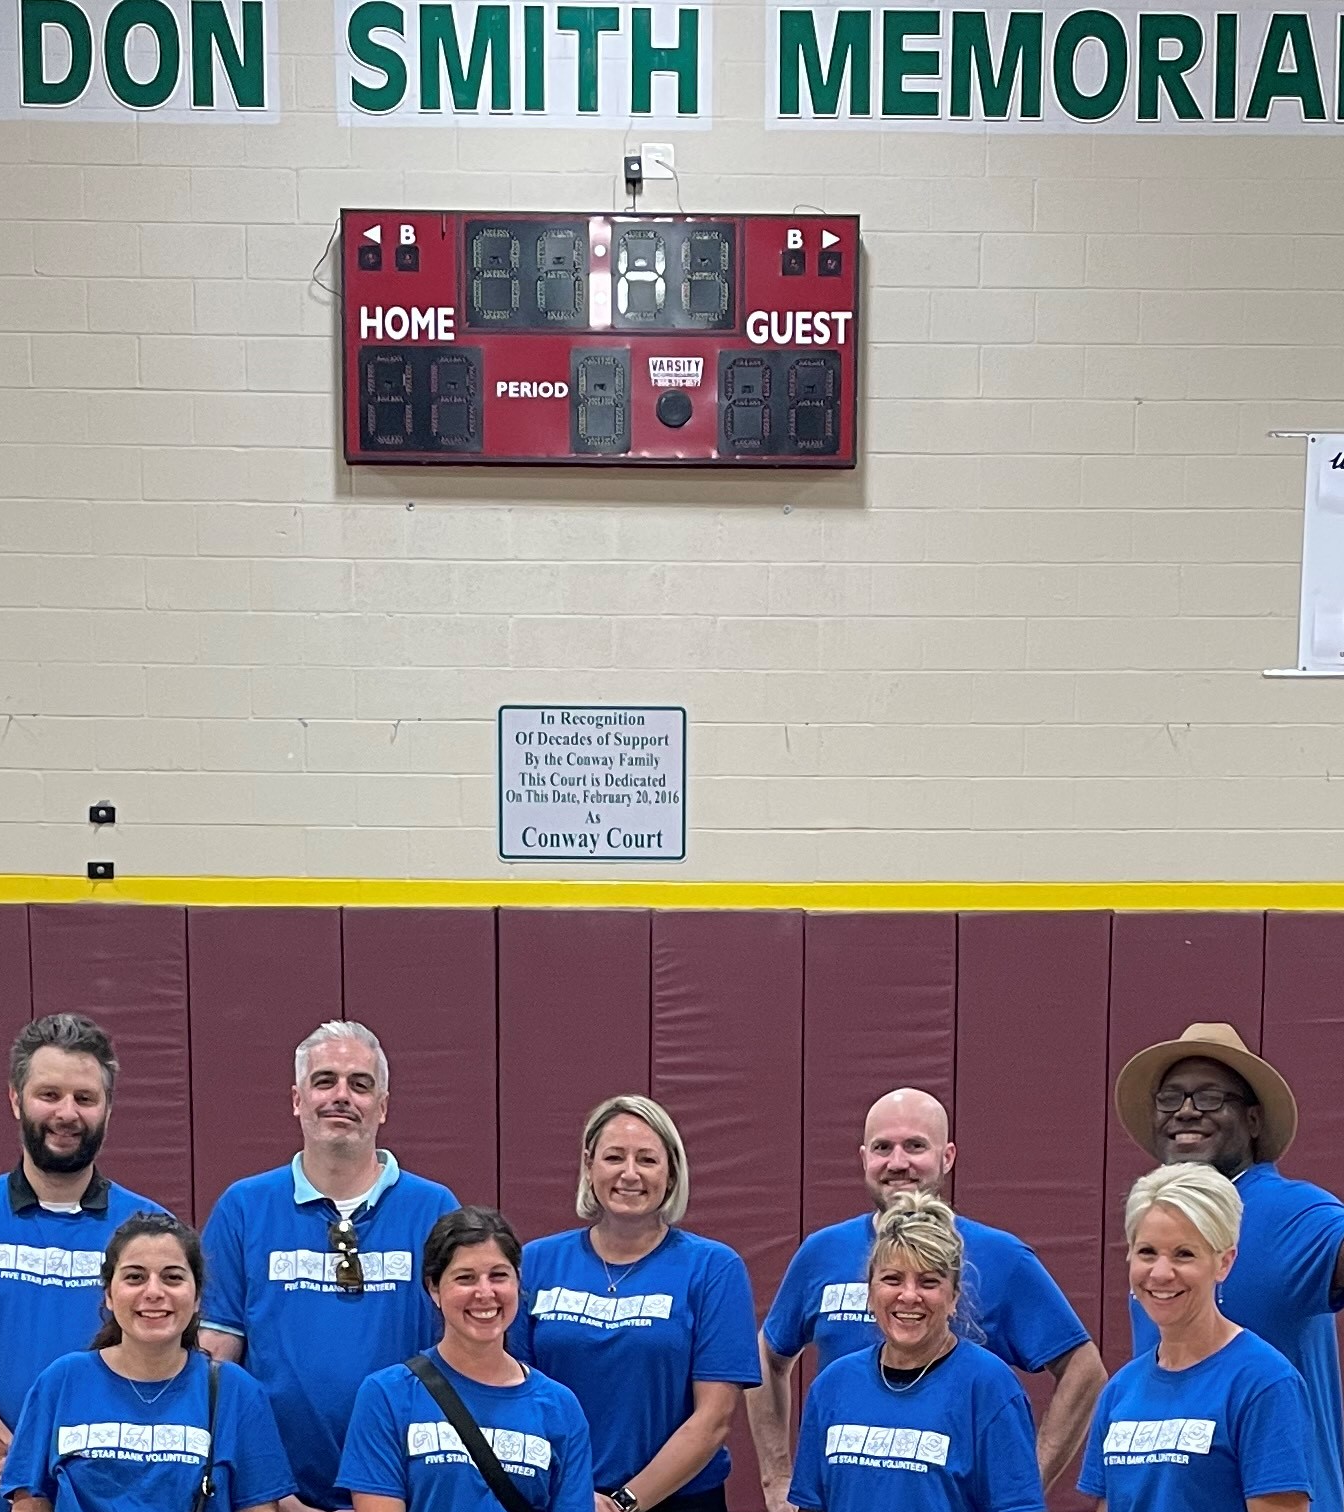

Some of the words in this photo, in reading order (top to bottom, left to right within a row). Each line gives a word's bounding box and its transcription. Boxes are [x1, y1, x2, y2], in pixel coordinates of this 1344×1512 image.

[20, 0, 267, 110] DON
[346, 0, 700, 117] SMITH
[400, 225, 415, 245] B
[787, 230, 803, 249] B
[360, 306, 455, 340] HOME
[746, 311, 852, 344] GUEST
[651, 359, 701, 372] VARSITY
[496, 381, 568, 398] PERIOD
[540, 711, 555, 725] In
[561, 711, 645, 729] Recognition
[515, 731, 534, 745] Of
[538, 732, 592, 746] Decades
[597, 732, 611, 746] of
[614, 733, 669, 749] Support
[525, 752, 540, 769] By
[544, 752, 563, 766] the
[566, 752, 614, 770] Conway
[619, 753, 660, 770] Family
[519, 772, 546, 786] This
[550, 772, 587, 787] Court
[591, 773, 600, 787] is
[605, 773, 666, 787] Dedicated
[506, 789, 522, 803] On
[525, 790, 548, 803] This
[552, 790, 580, 805] Date,
[583, 790, 632, 807] February
[636, 791, 652, 805] 20,
[655, 791, 679, 804] 2016
[585, 811, 601, 824] As
[522, 826, 600, 854] Conway
[607, 827, 663, 848] Court
[0, 1270, 19, 1280] FIVE
[20, 1272, 41, 1285] STAR
[42, 1277, 63, 1287] BANK
[64, 1278, 104, 1288] VOLUNT
[300, 1280, 320, 1291] STAR
[557, 1313, 578, 1322] STAR
[579, 1316, 603, 1328] BANK
[843, 1313, 862, 1321] STAR
[91, 1449, 115, 1459] STAR
[117, 1451, 143, 1462] BANK
[146, 1453, 200, 1465] VOLUNTEER
[425, 1453, 445, 1465] FIVE
[446, 1453, 468, 1464] STAR
[839, 1455, 858, 1464] STAR
[859, 1456, 881, 1468] BANK
[882, 1460, 928, 1473] VOLUNTEER
[1127, 1455, 1145, 1465] BANK
